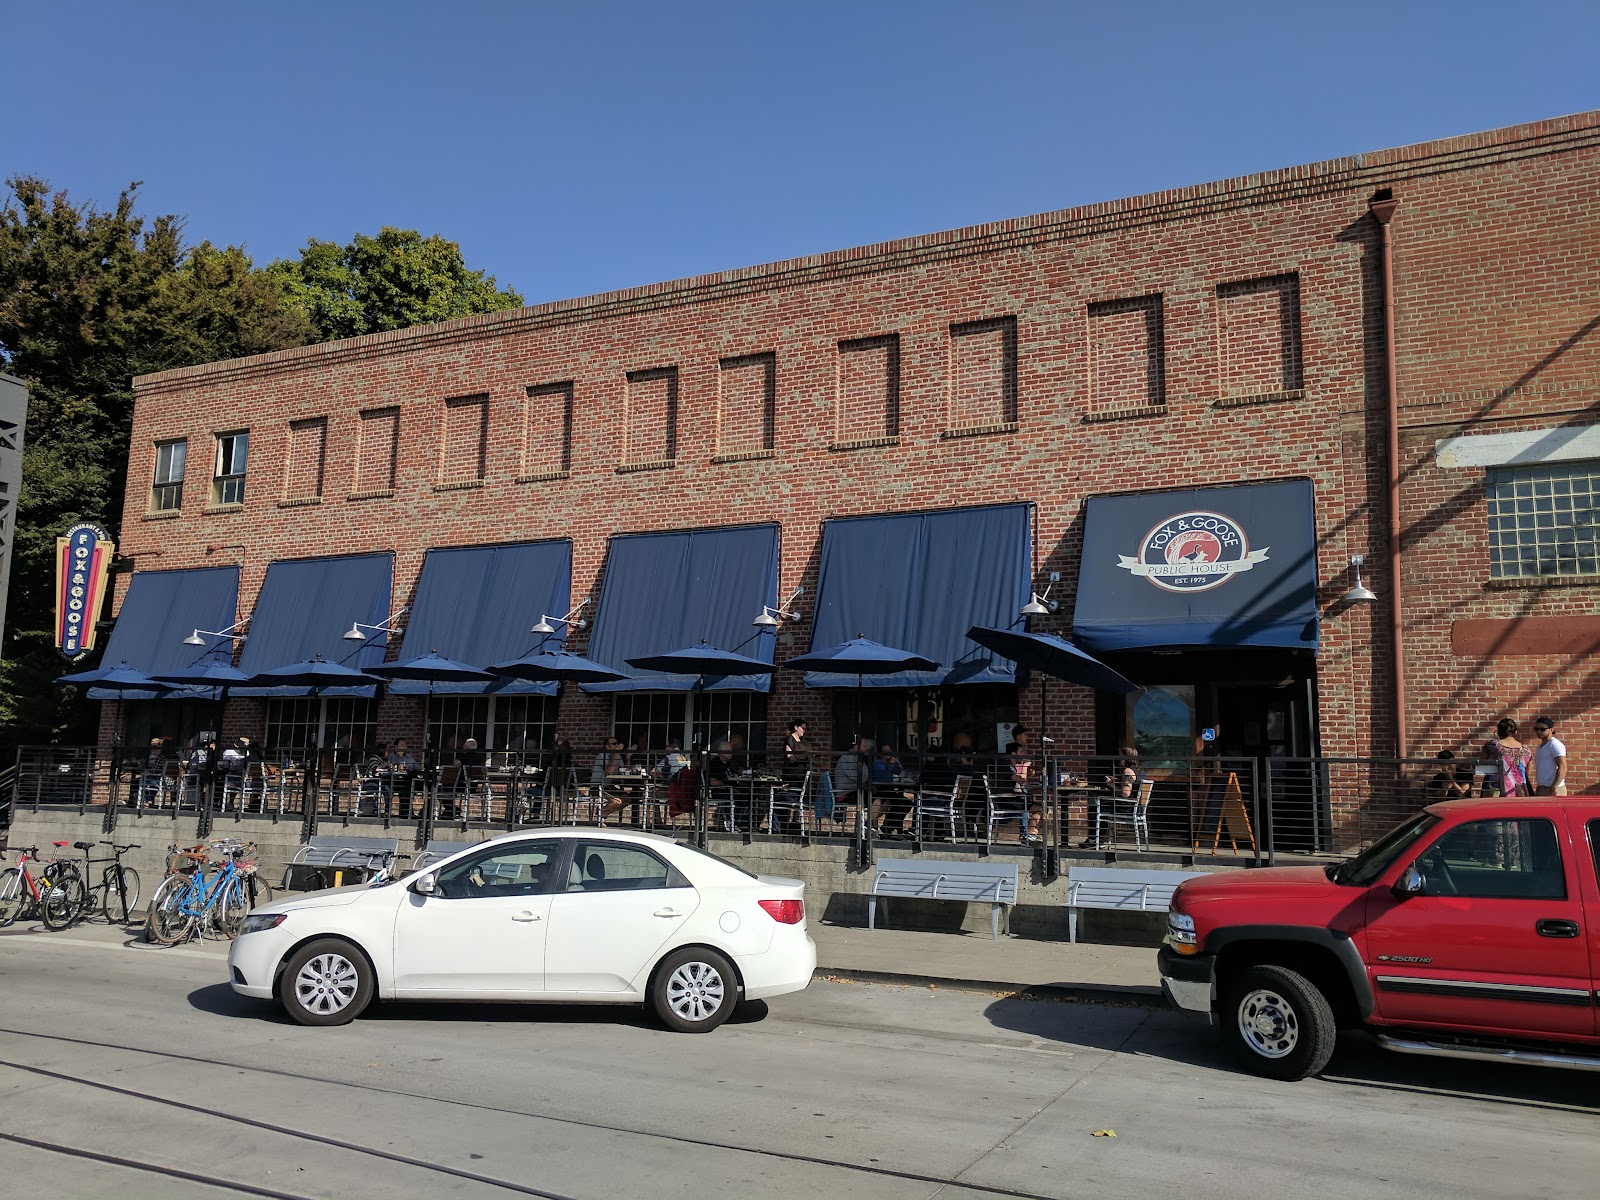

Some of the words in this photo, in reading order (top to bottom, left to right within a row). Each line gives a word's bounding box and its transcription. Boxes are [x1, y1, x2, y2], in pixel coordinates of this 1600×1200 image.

[1150, 526, 1176, 549] FOX
[1178, 520, 1190, 530] &
[1192, 518, 1239, 547] GOOSE
[75, 534, 88, 571] FOX
[72, 573, 85, 585] &
[1148, 566, 1186, 574] PUBLIC
[1191, 564, 1232, 573] HOUSE
[67, 586, 84, 649] GOOSE
